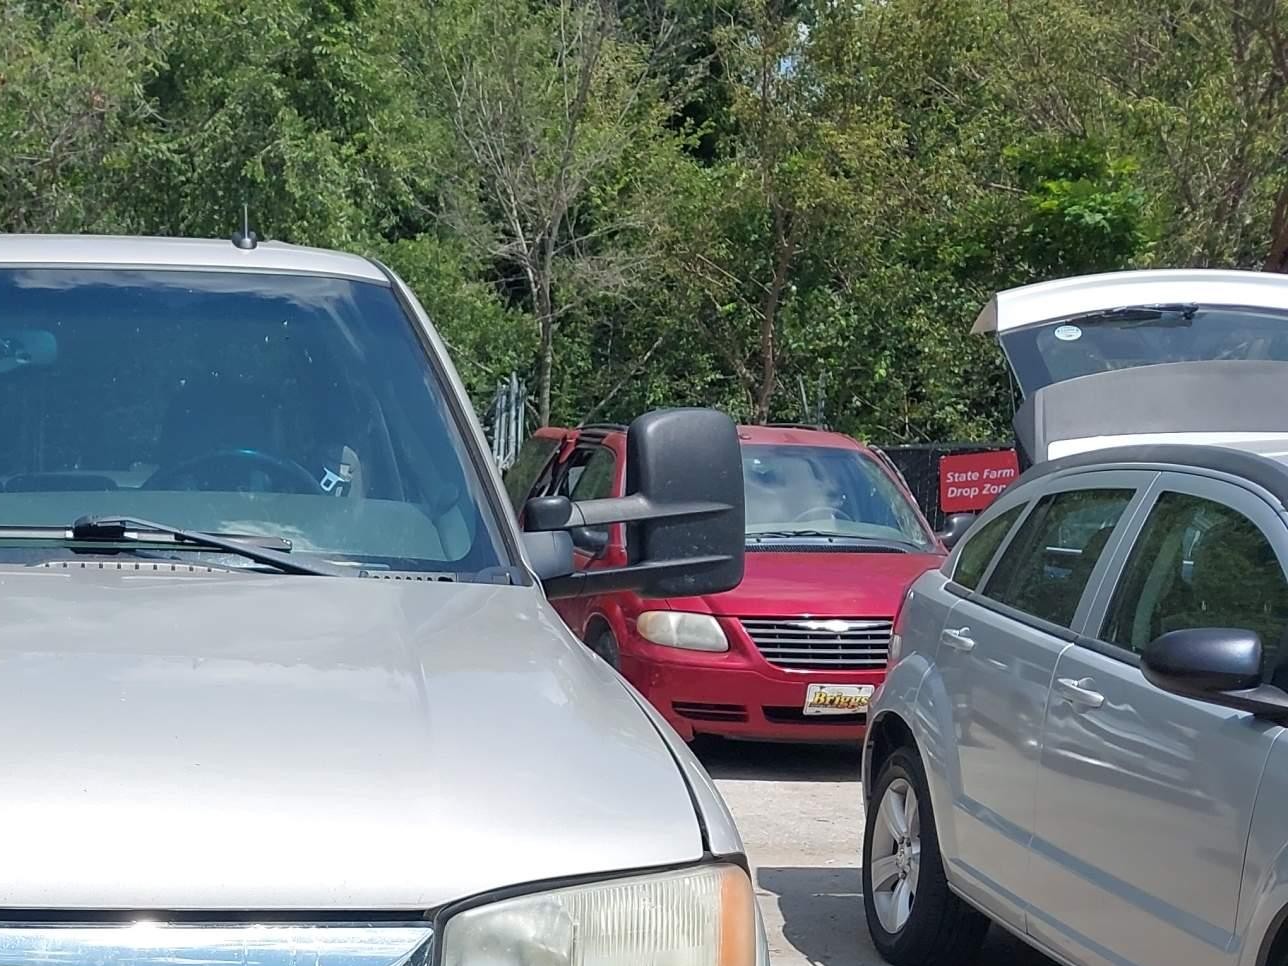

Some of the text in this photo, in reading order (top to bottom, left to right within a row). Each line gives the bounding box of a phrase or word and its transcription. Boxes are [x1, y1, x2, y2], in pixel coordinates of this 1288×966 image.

[946, 468, 1015, 483] State Farm
[947, 483, 1006, 499] Drop Zon
[813, 692, 868, 709] Briggs
